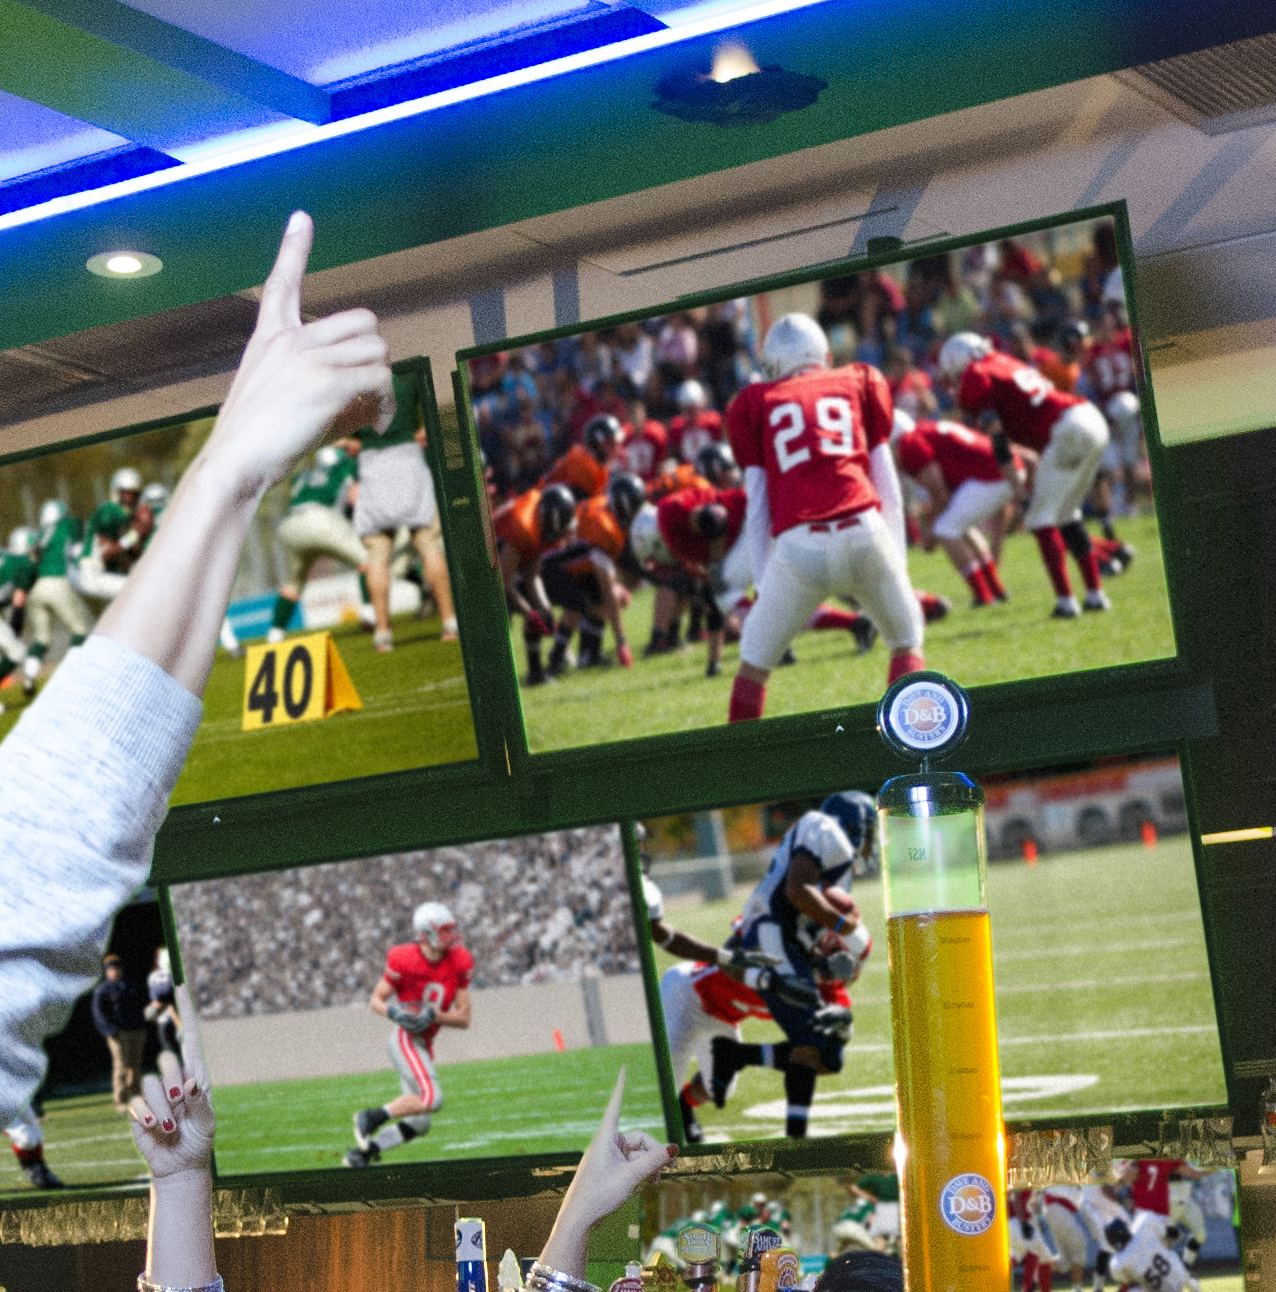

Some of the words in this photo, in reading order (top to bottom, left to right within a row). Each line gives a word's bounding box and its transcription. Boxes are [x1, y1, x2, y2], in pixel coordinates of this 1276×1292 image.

[769, 397, 853, 474] 29
[249, 645, 312, 723] 40
[903, 706, 947, 726] D&B
[948, 1195, 992, 1215] D&B
[1144, 1254, 1170, 1290] 58
